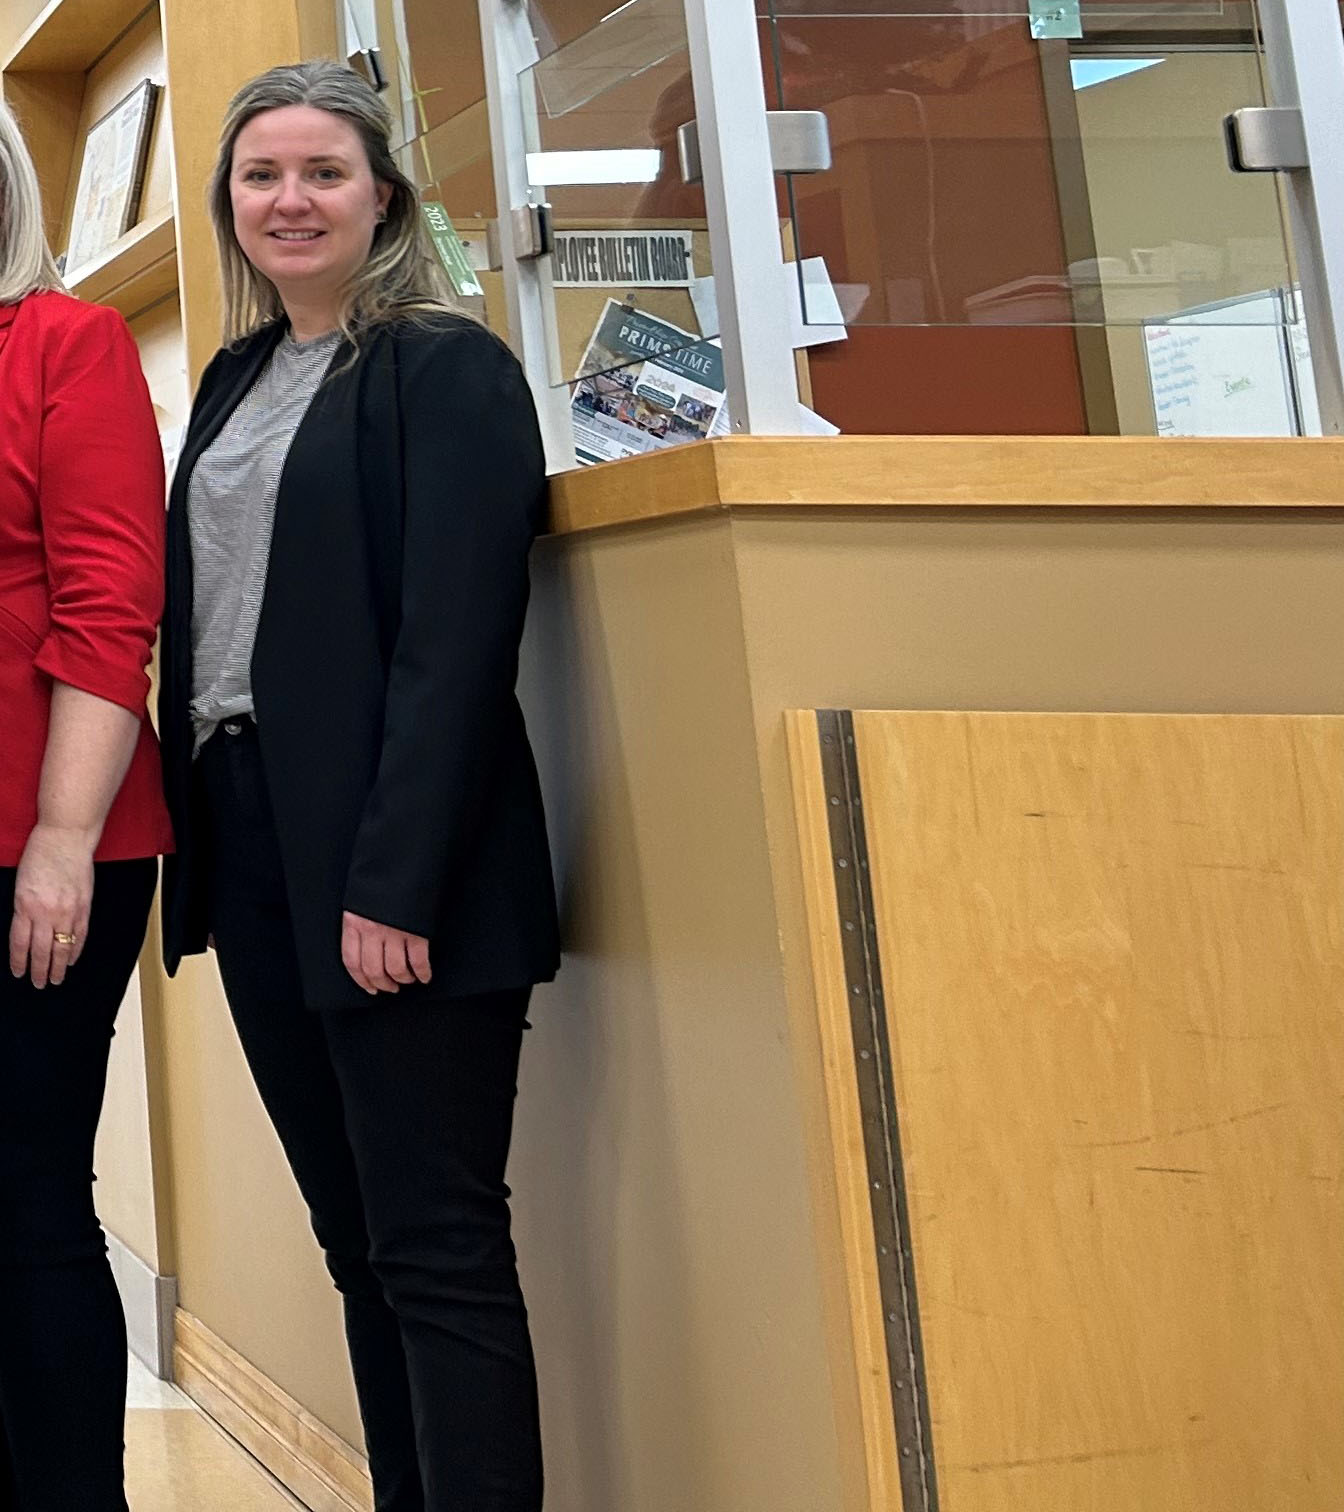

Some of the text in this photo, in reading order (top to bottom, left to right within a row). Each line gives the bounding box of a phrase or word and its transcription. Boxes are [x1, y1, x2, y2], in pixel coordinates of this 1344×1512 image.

[423, 206, 449, 232] 2023
[598, 236, 651, 282] BULLETIN
[650, 236, 689, 282] BOARD
[674, 348, 713, 375] TIME
